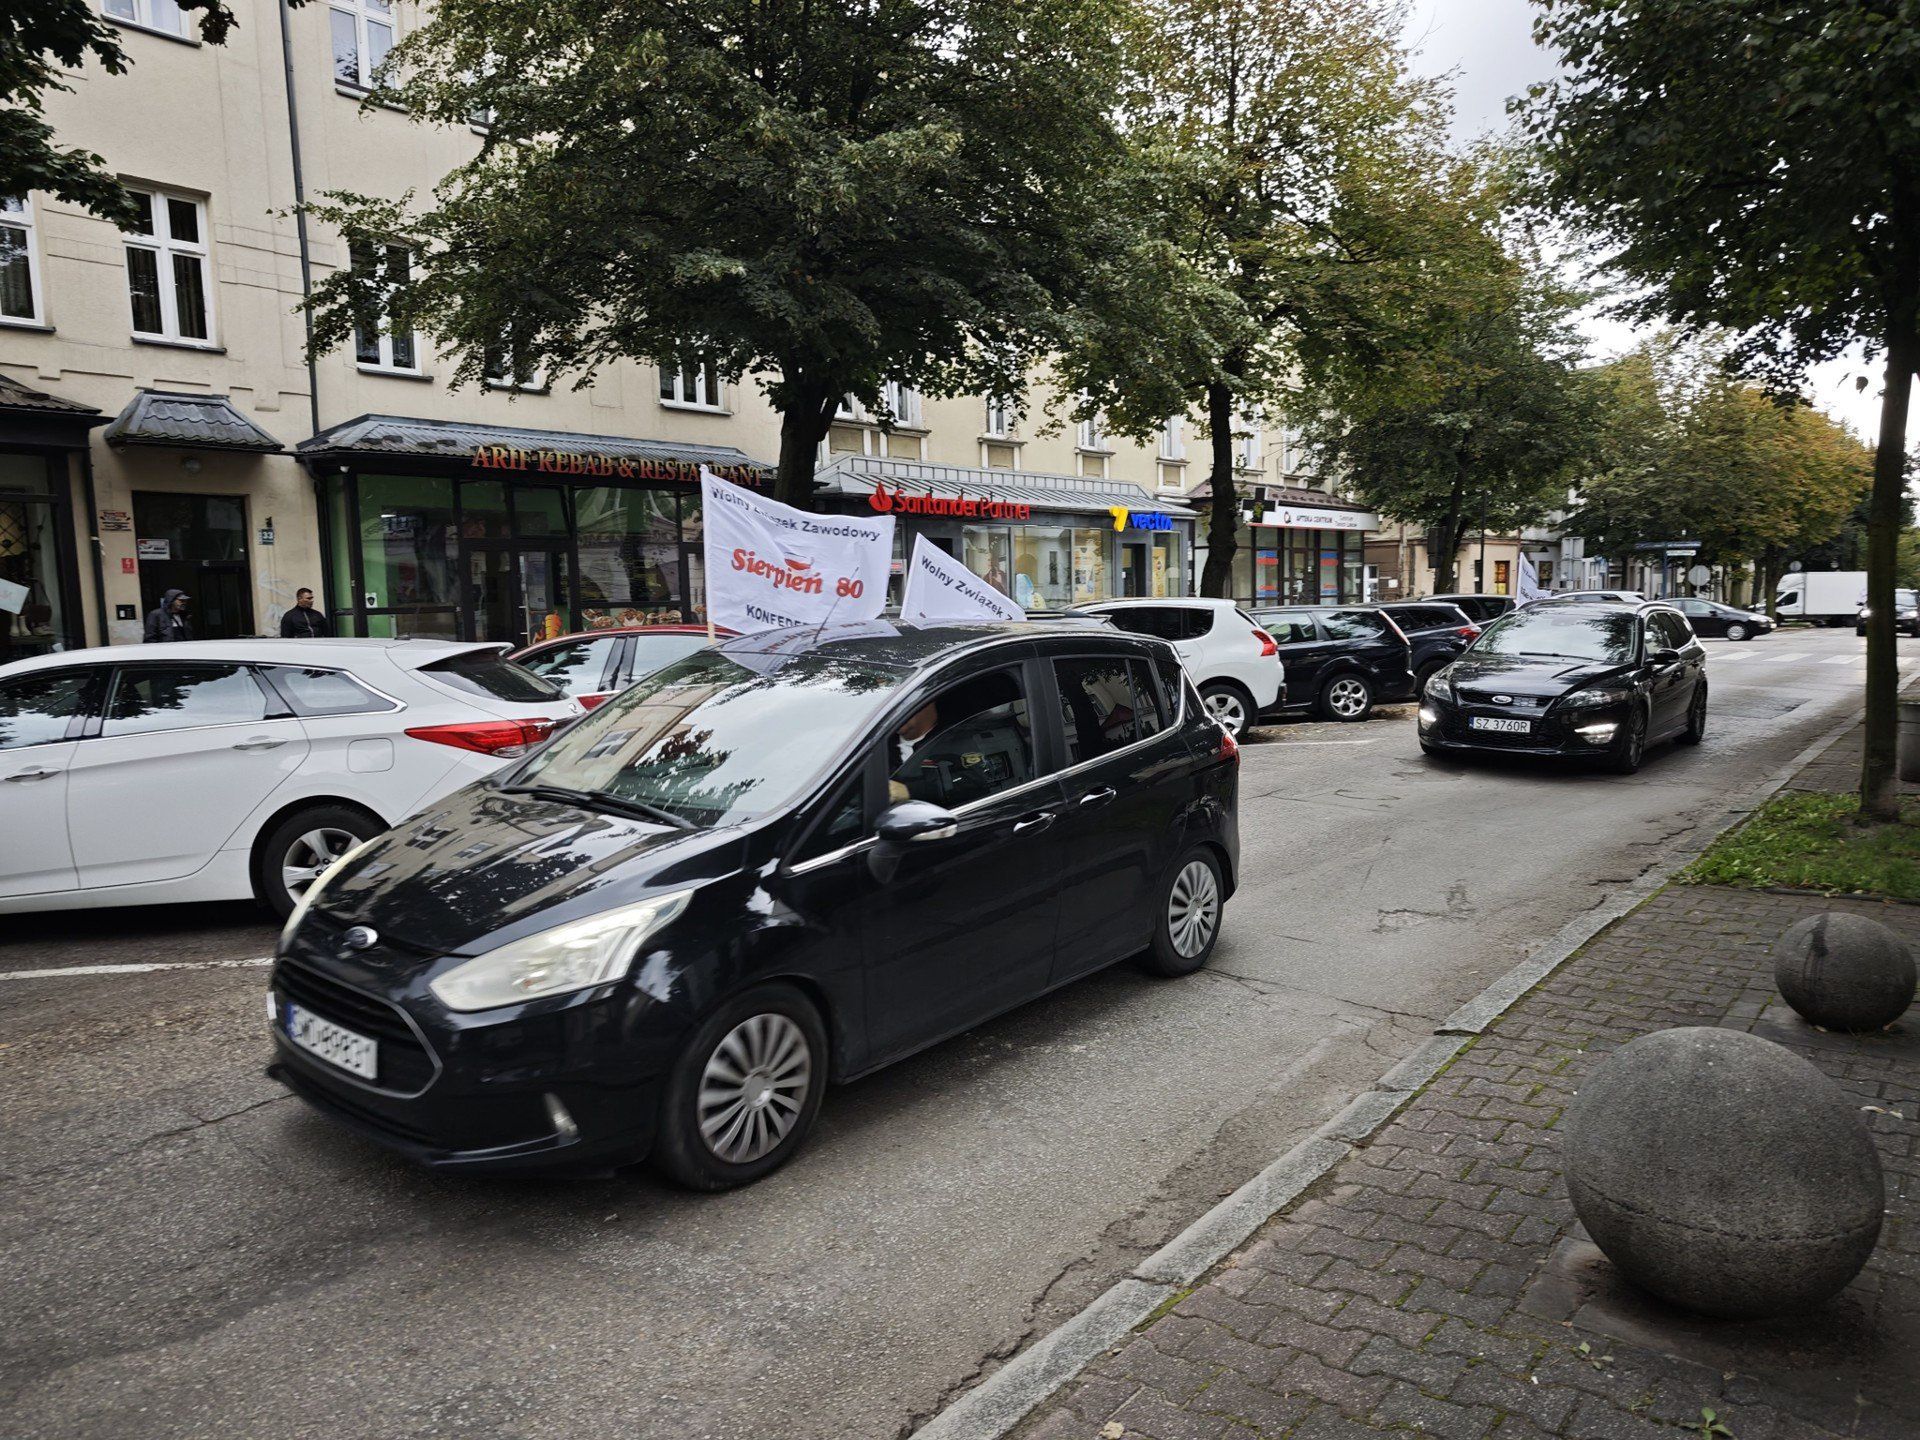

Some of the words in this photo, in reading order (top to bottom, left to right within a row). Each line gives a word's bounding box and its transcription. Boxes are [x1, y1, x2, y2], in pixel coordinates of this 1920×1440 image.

[472, 445, 530, 470] ARIF
[537, 449, 612, 477] KEBAB
[618, 456, 634, 478] &
[640, 459, 763, 486] RESTARANT
[711, 487, 750, 510] Wolny
[802, 521, 880, 541] Zawodowy
[894, 488, 977, 517] Santander
[980, 496, 1031, 520] Partner
[732, 548, 823, 594] Sierpień
[836, 577, 864, 598] 80
[921, 555, 954, 586] Wolny
[955, 580, 1004, 618] Związek
[746, 604, 810, 628] KONFEDE
[1475, 718, 1489, 729] SZ
[1493, 719, 1528, 732] 3760R
